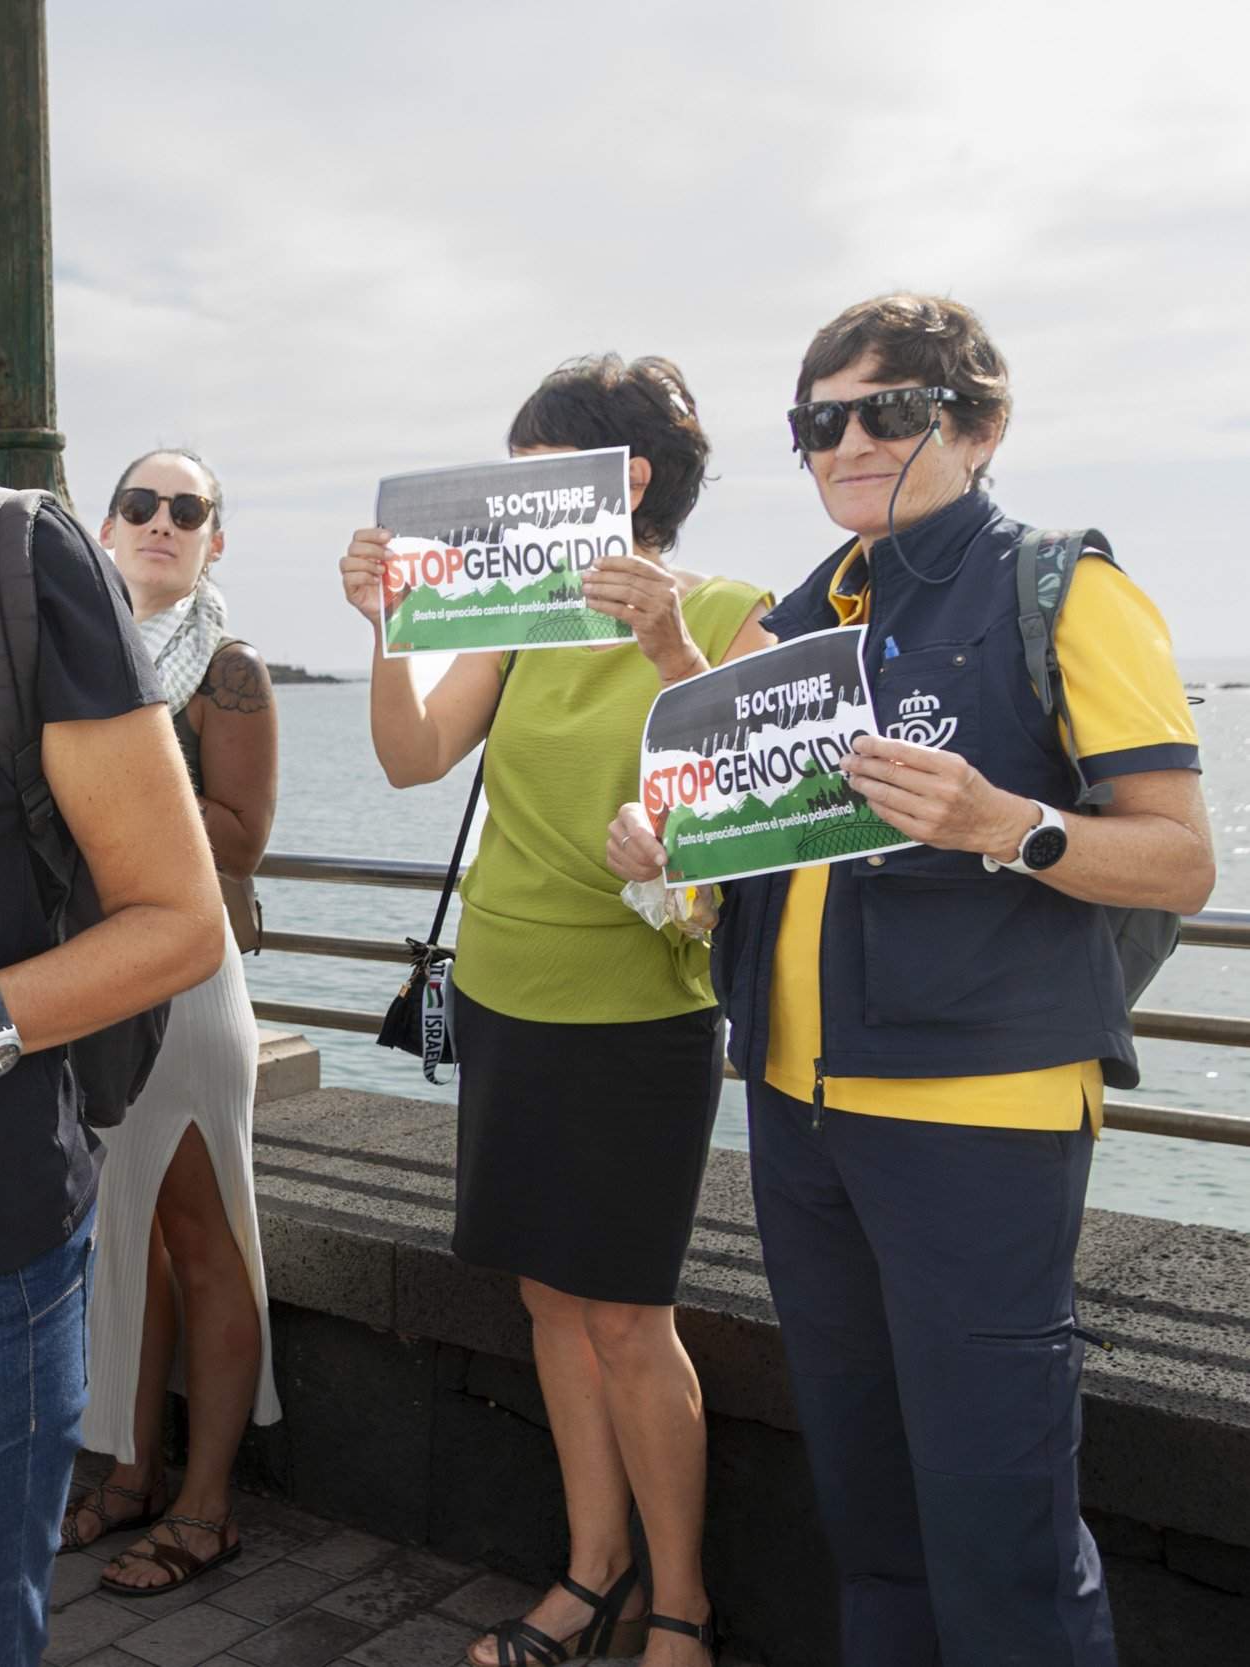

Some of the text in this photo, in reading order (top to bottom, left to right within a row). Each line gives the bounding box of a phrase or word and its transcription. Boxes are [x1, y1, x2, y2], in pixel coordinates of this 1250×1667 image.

[486, 485, 595, 518] 15 OCTUBRE
[445, 605, 482, 621] genocidio
[483, 602, 510, 616] contra
[518, 600, 545, 616] pueblo
[735, 673, 834, 721] 15 OCTUBRE
[705, 824, 742, 844] genocidio
[742, 820, 770, 835] contra
[770, 816, 778, 829] el
[778, 812, 807, 831] pueblo
[808, 801, 855, 825] palestino!
